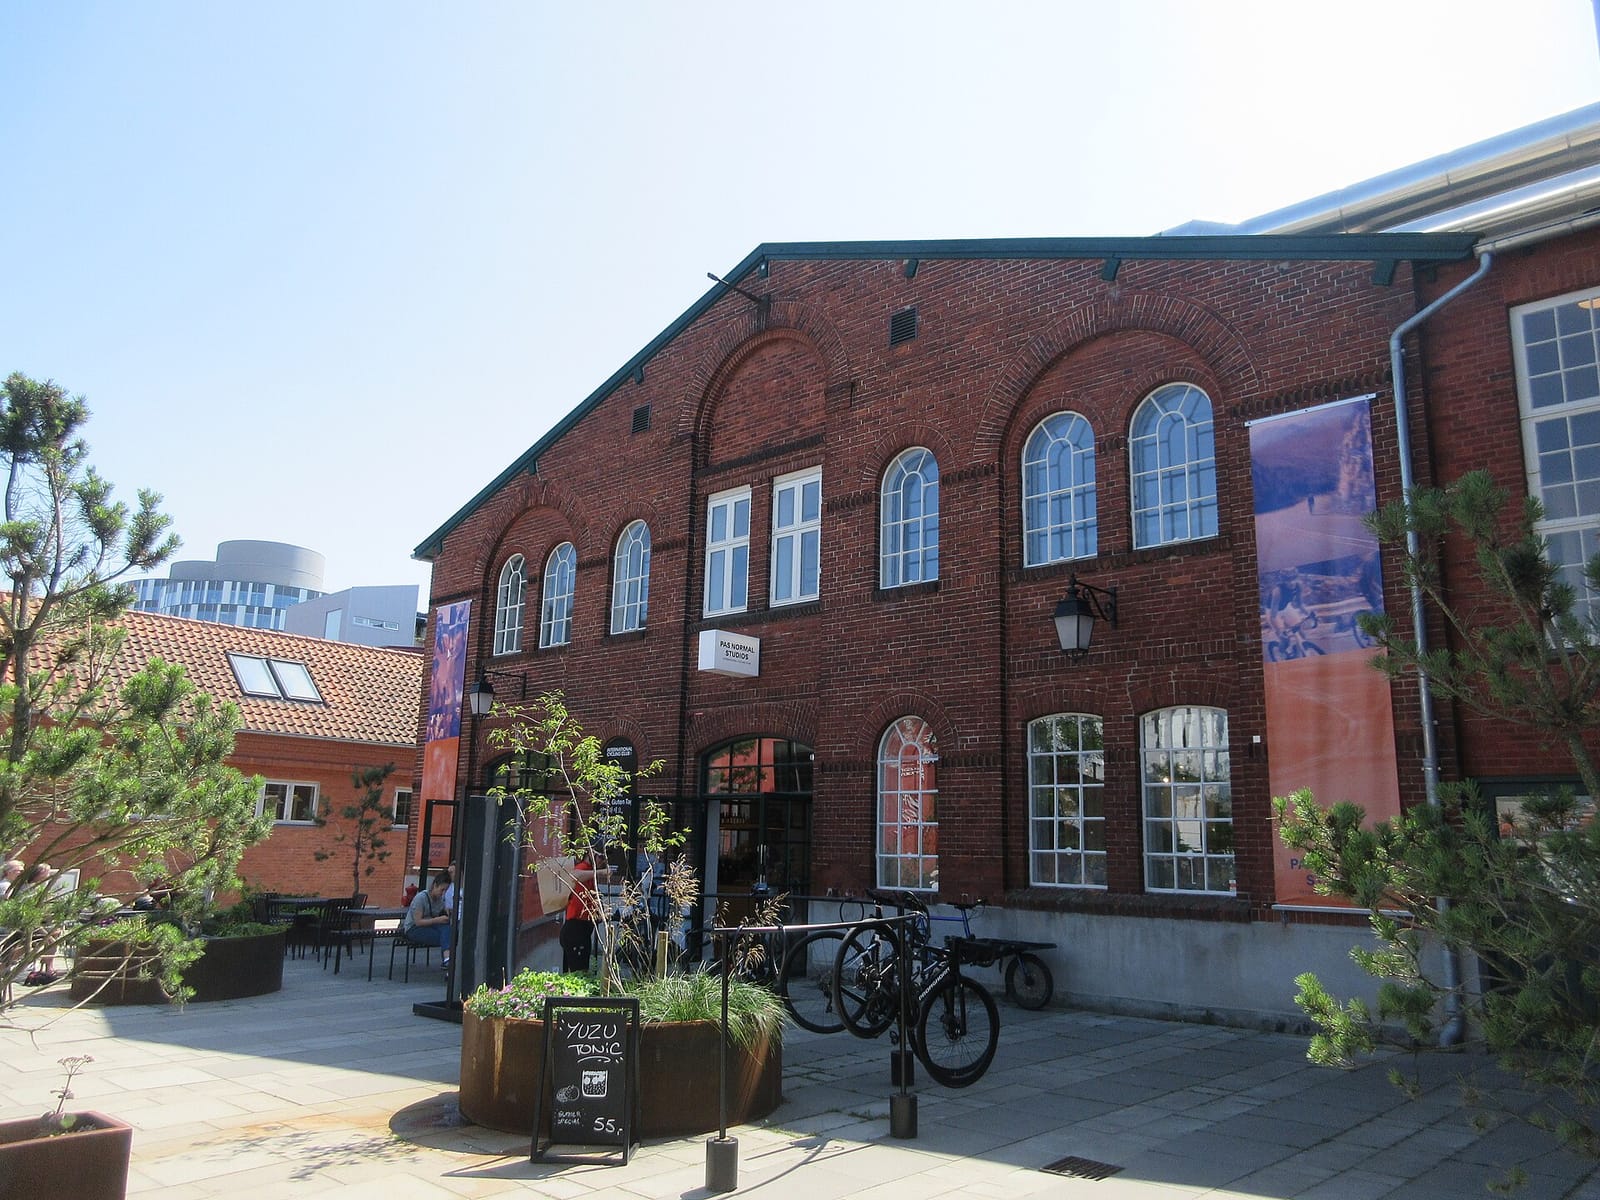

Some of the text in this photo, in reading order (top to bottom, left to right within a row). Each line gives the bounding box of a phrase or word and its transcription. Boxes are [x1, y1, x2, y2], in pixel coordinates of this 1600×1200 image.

[720, 641, 755, 653] PAS NORMAL
[725, 650, 749, 660] STUDIOS
[567, 1022, 617, 1039] YUZU
